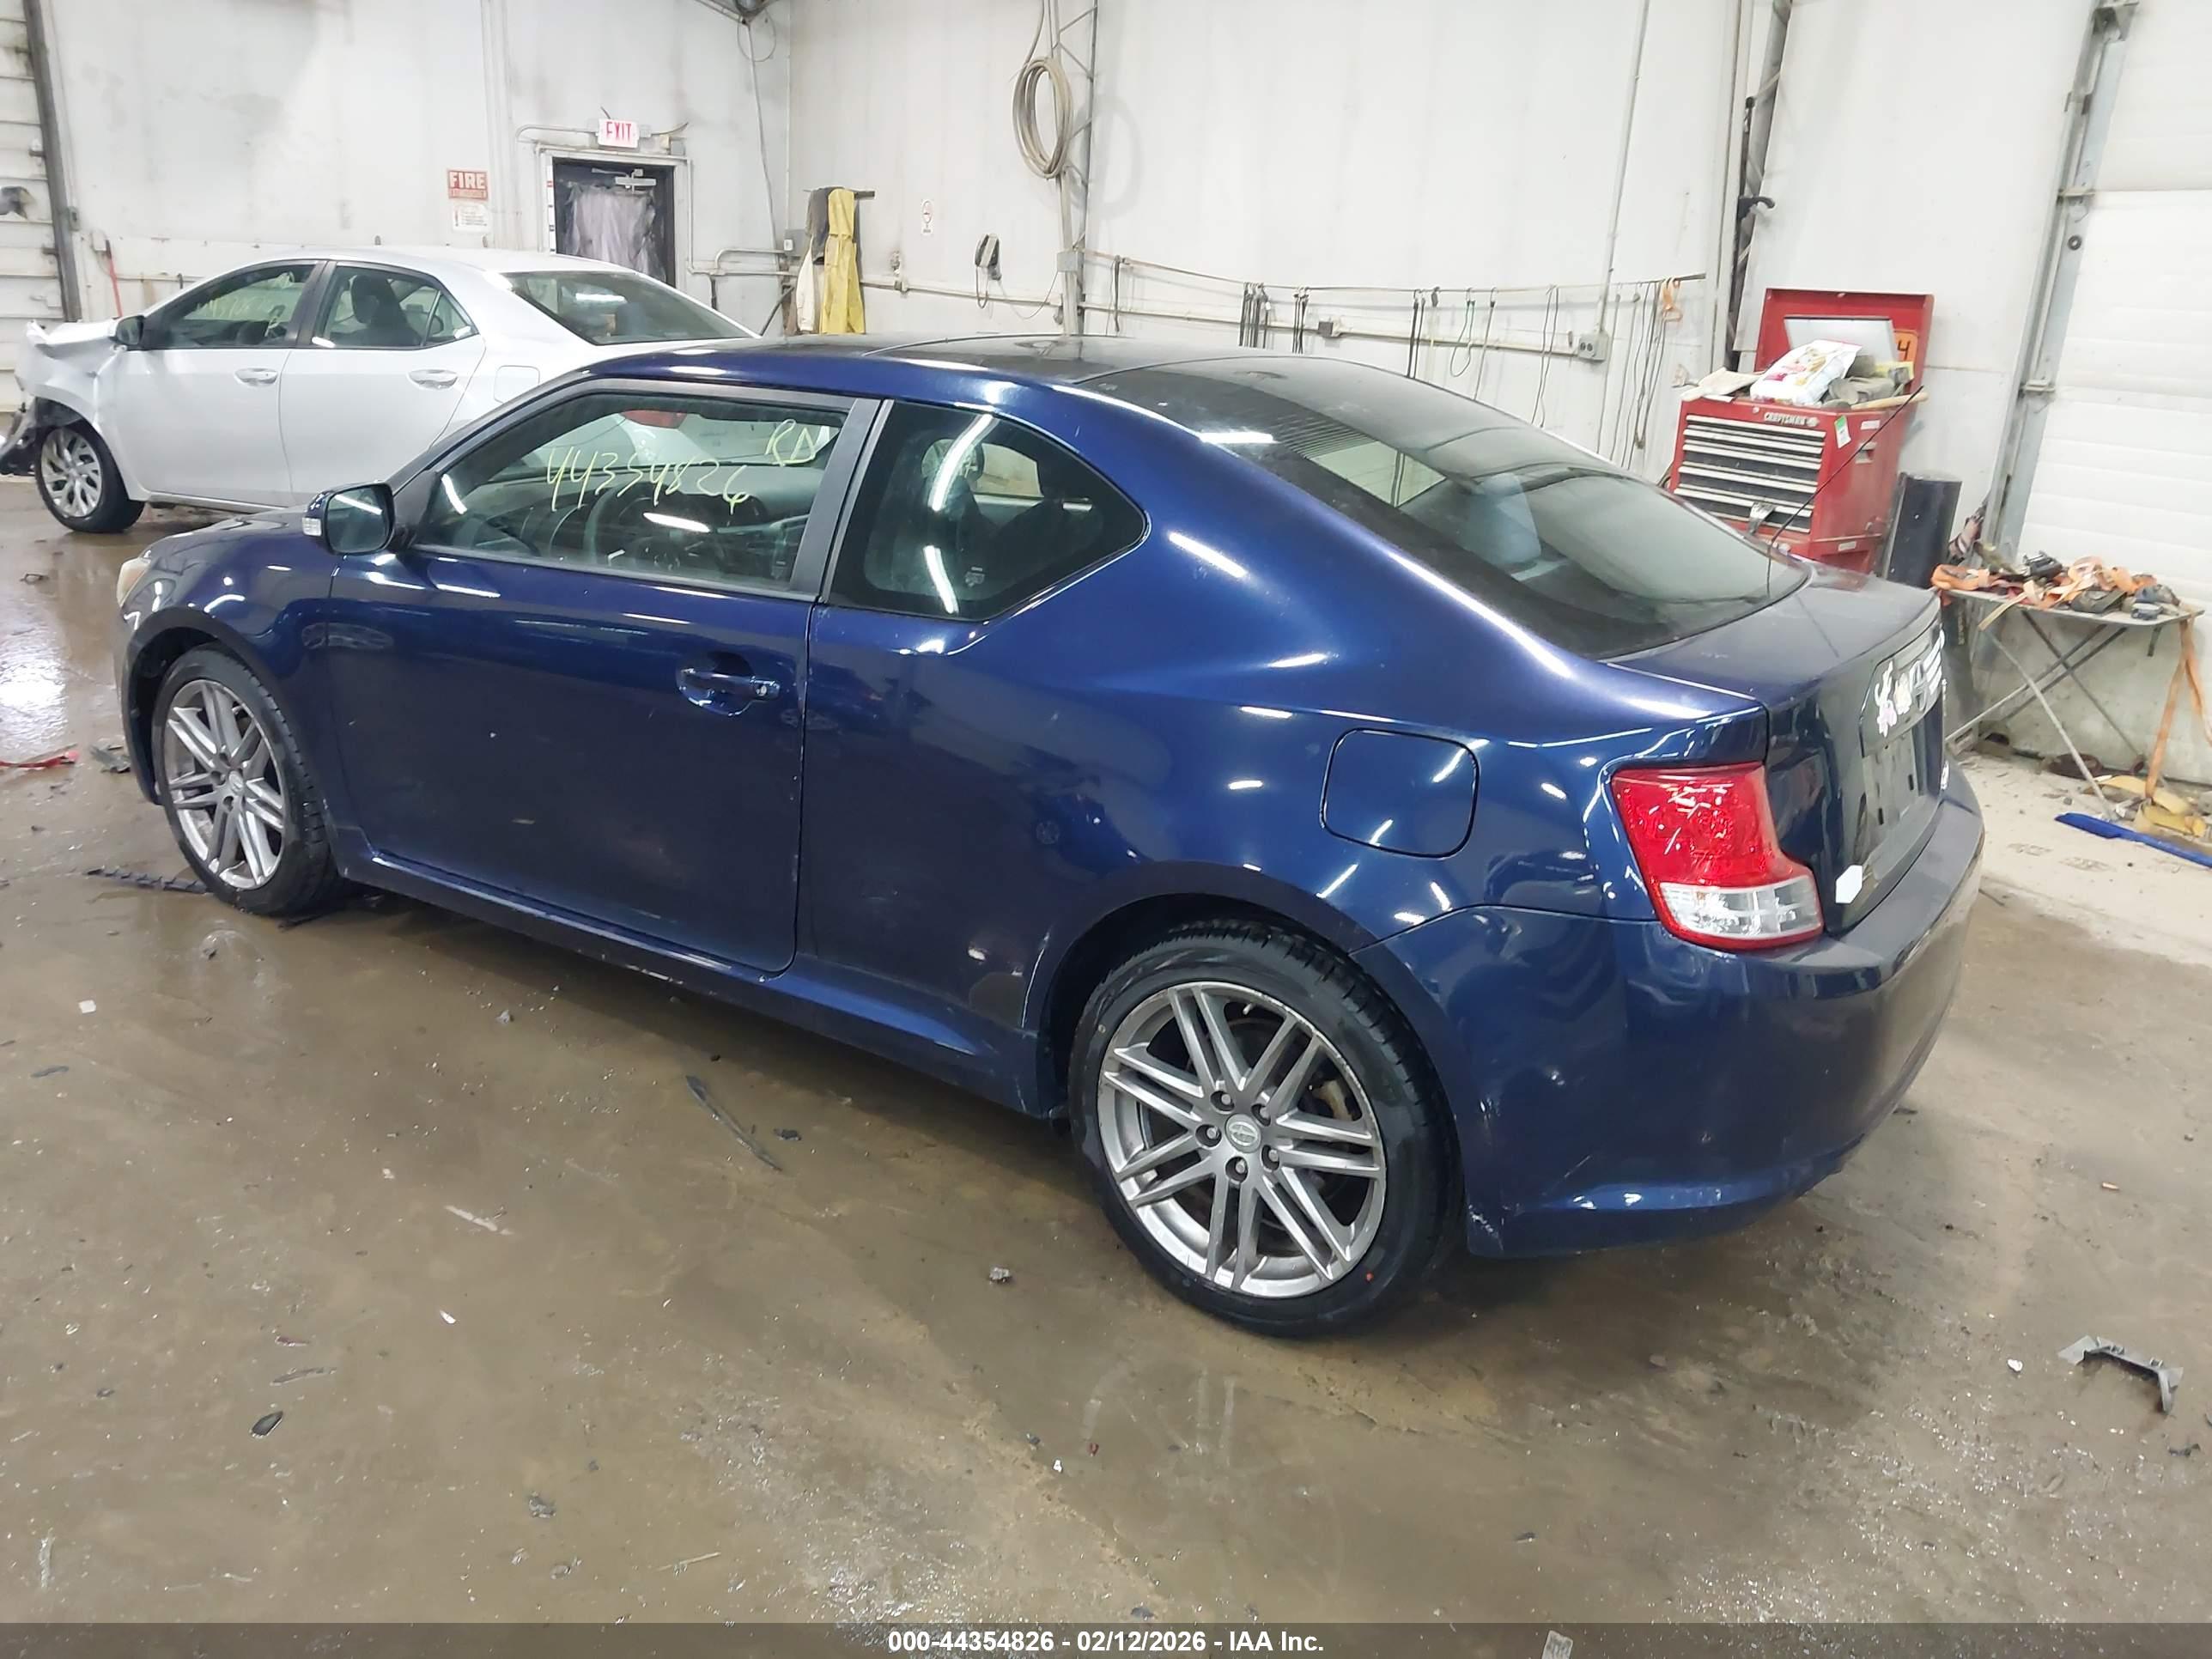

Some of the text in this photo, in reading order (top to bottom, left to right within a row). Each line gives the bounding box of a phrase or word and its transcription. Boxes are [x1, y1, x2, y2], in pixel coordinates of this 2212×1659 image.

[605, 121, 632, 141] EXIT
[449, 171, 486, 189] FIRE
[546, 447, 750, 514] 44354826
